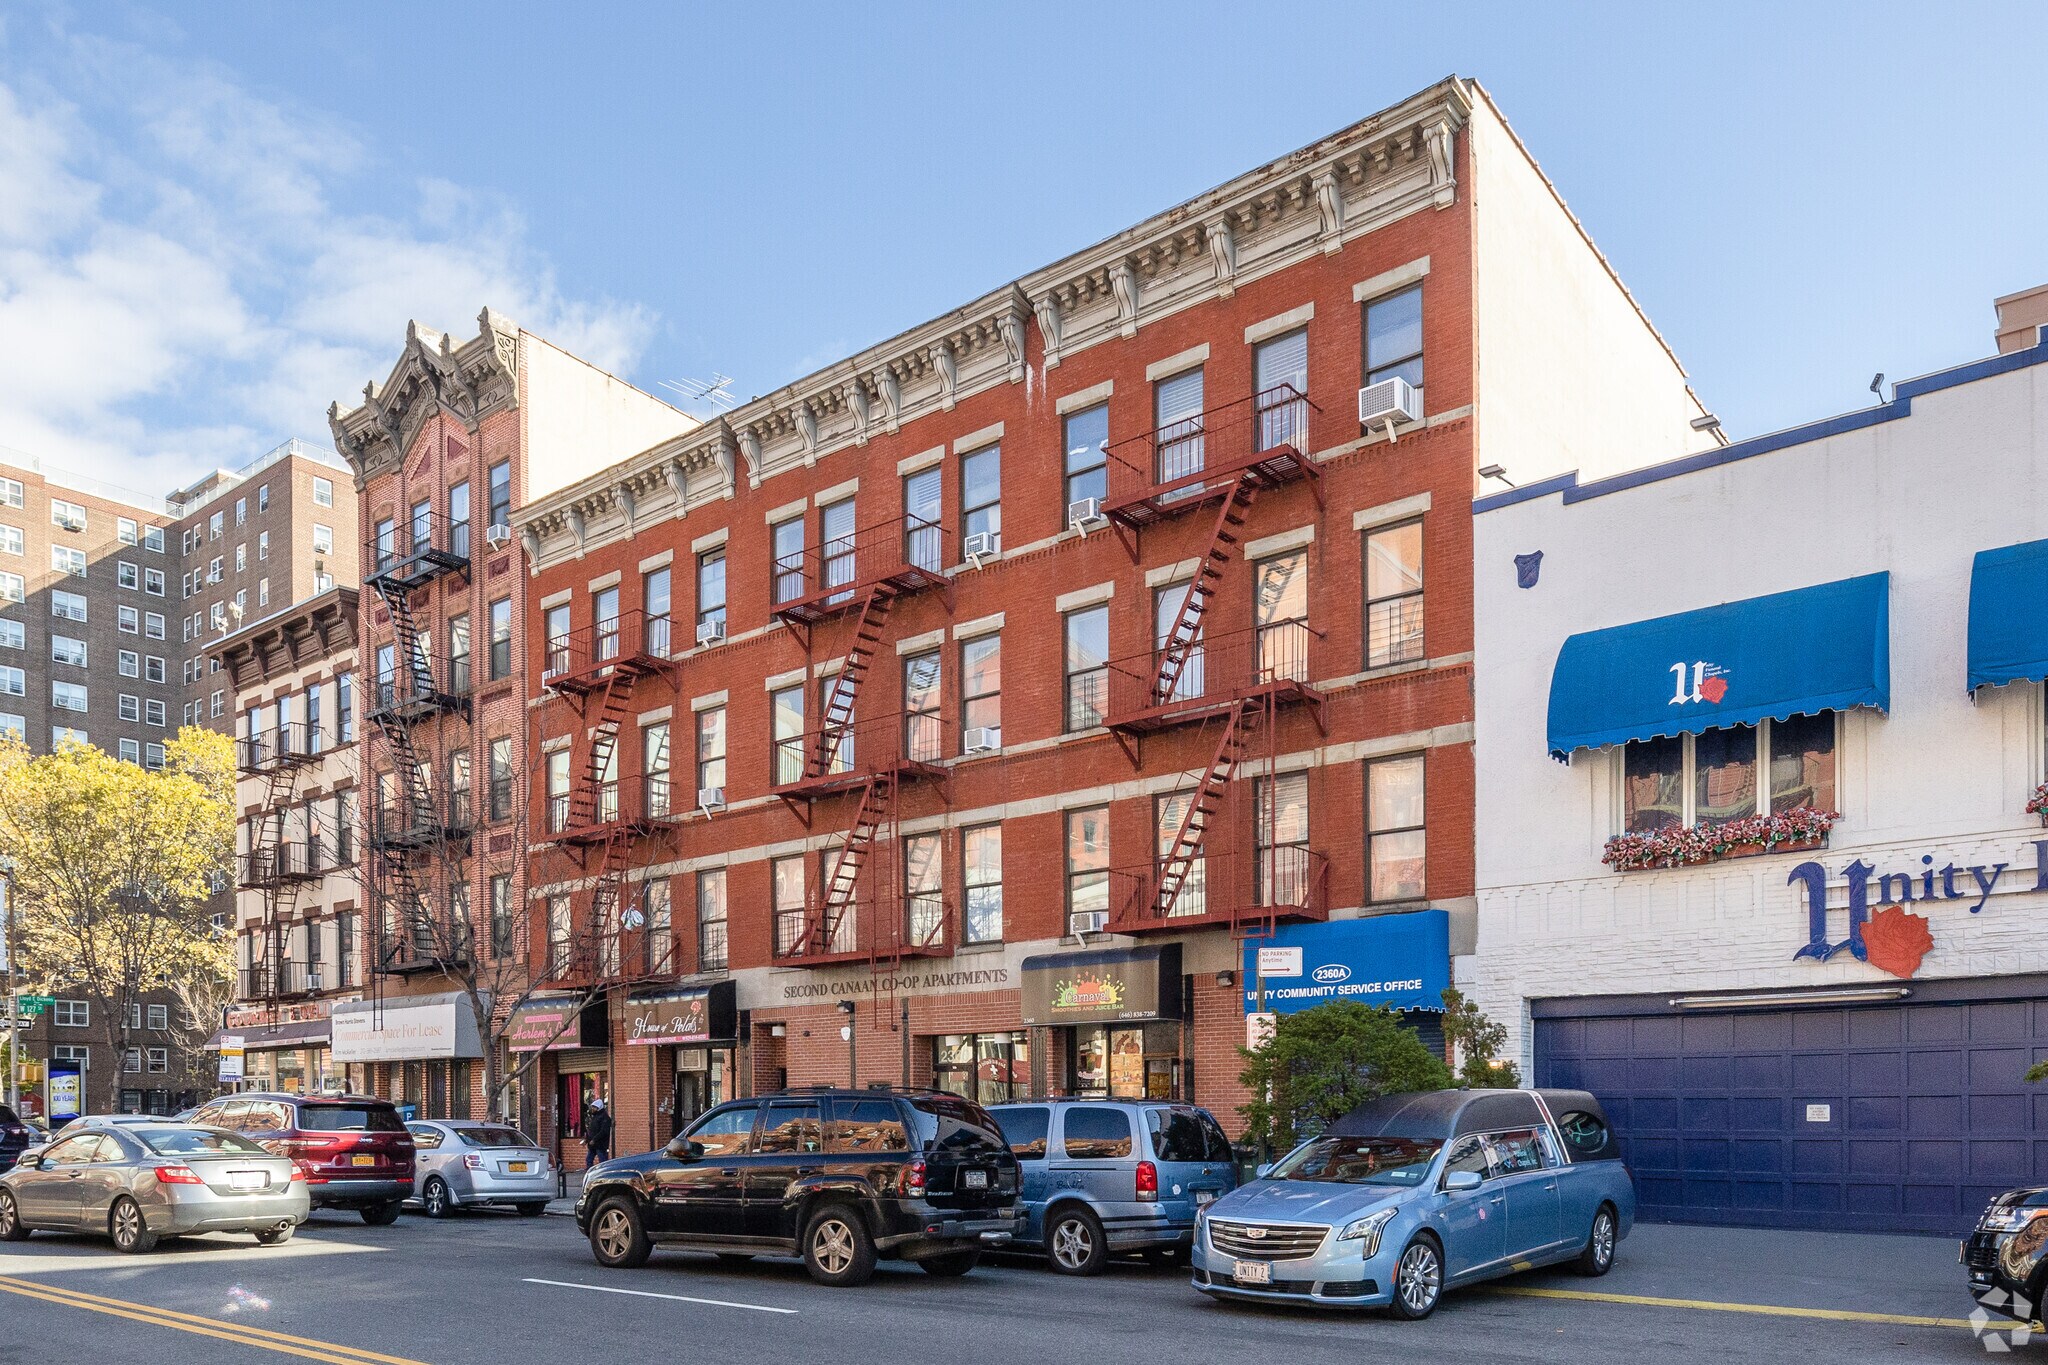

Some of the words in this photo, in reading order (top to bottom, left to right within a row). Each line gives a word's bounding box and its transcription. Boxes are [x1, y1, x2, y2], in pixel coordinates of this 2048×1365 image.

[1787, 854, 2009, 963] Unity
[1317, 969, 1346, 980] 2360A
[783, 983, 828, 998] SECOND
[831, 979, 877, 995] CANAAN
[882, 975, 920, 991] CO-OP
[922, 968, 1008, 988] APARTMENTS
[1247, 989, 1276, 1000] UNTY
[1276, 986, 1336, 999] COMMUNITY
[1338, 982, 1382, 995] SERVICE
[1384, 979, 1422, 991] OFFICE
[1065, 988, 1110, 1003] Carnaval
[27, 1005, 36, 1013] 127
[402, 1024, 417, 1038] For
[419, 1022, 443, 1037] Lease
[512, 1022, 553, 1040] Harlem's
[406, 1113, 412, 1121] P
[1240, 1265, 1258, 1277] UNITY
[1261, 1267, 1265, 1278] 2
